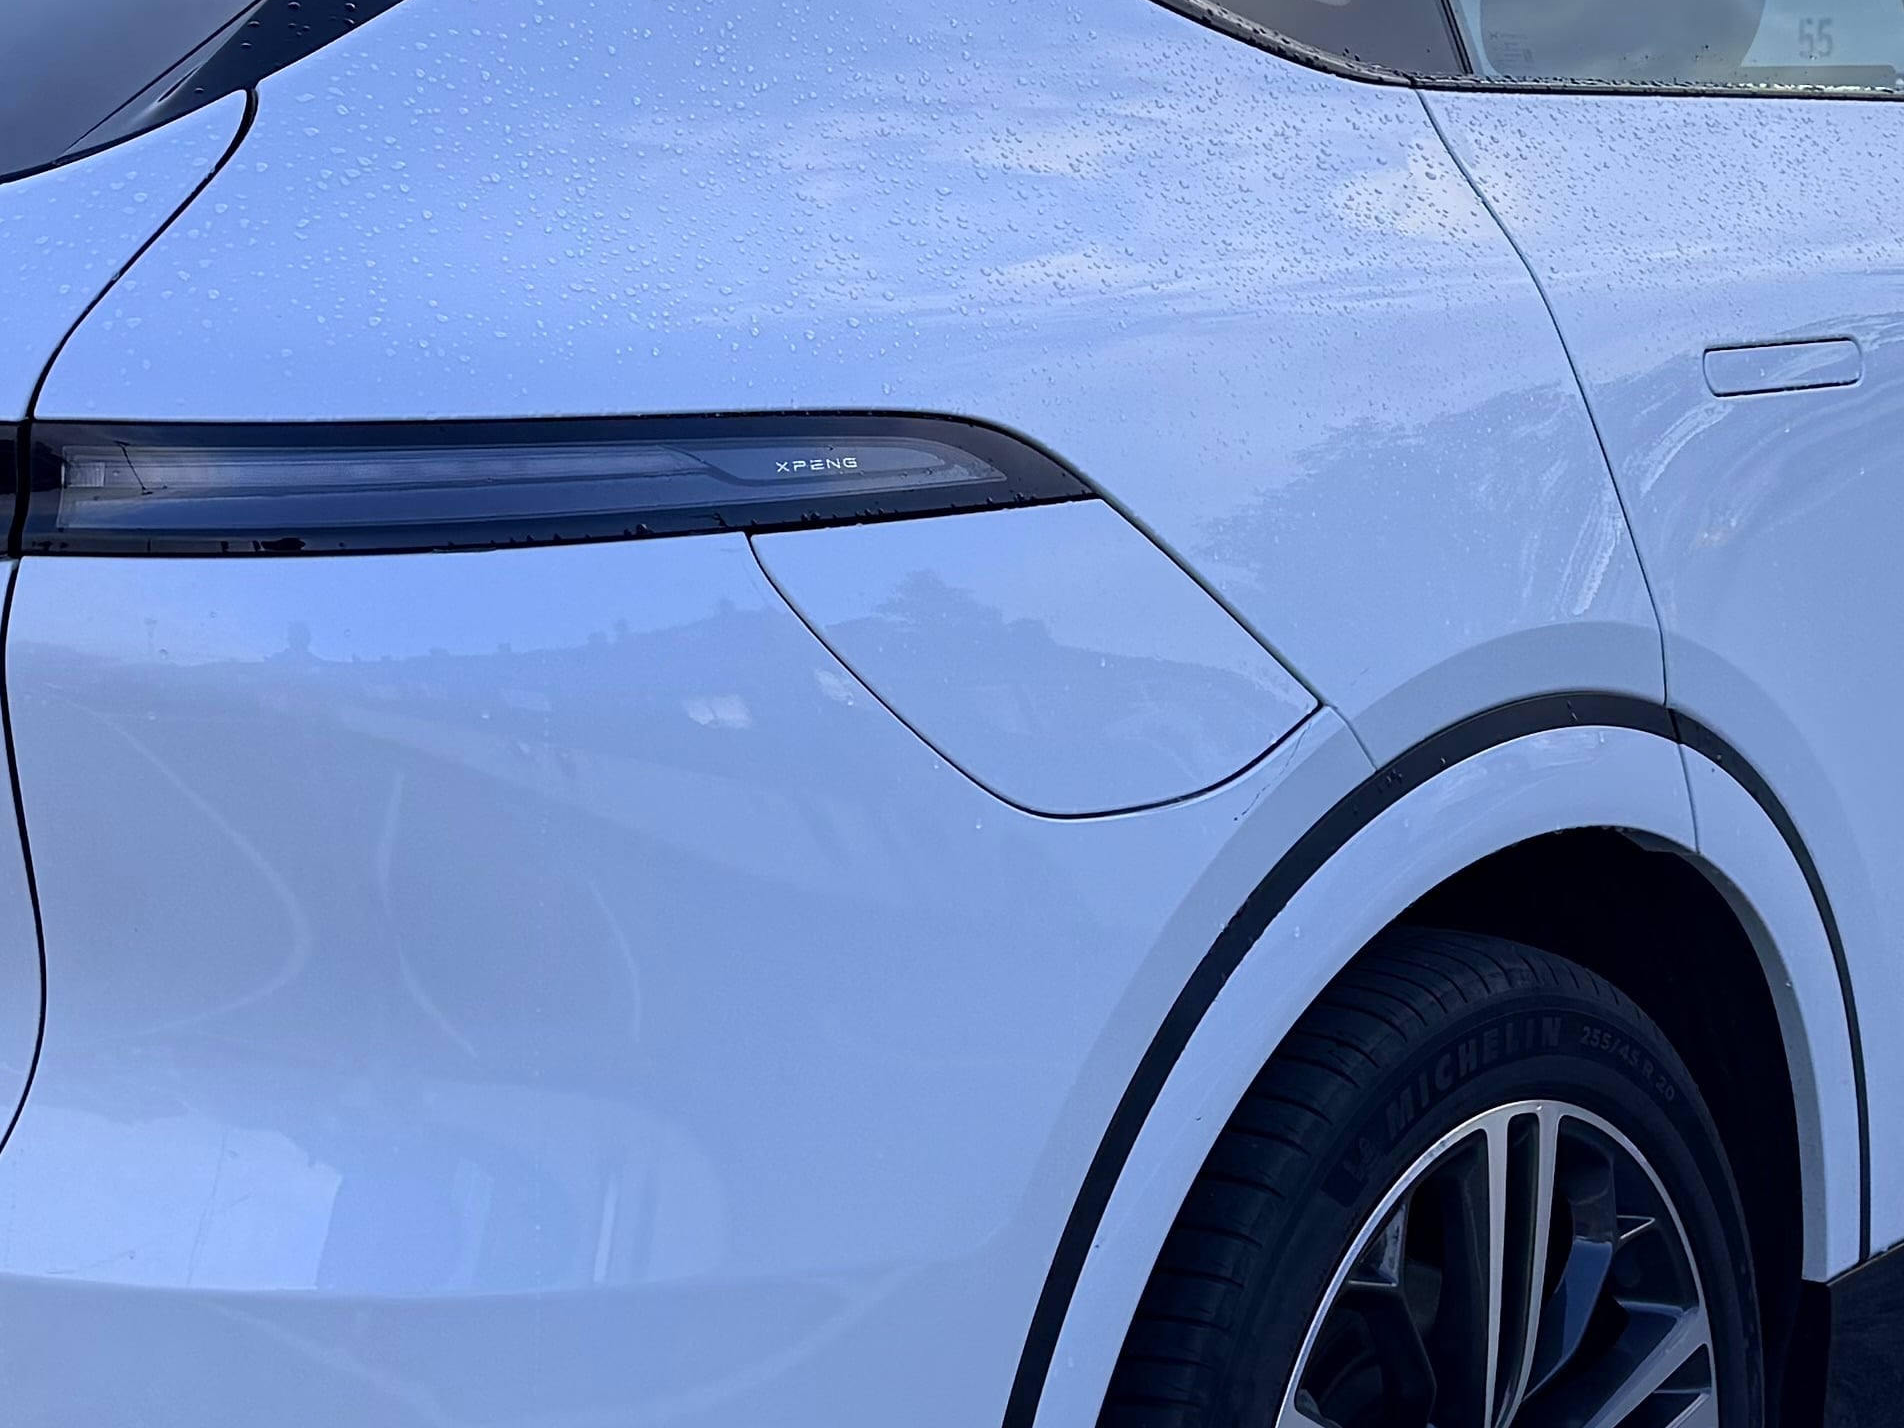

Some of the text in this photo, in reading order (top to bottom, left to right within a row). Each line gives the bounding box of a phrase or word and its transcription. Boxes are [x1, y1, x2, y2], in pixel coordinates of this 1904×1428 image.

[1798, 18, 1833, 59] 55
[776, 457, 858, 473] XPENG
[1385, 1016, 1561, 1136] MICHELIN
[1580, 1025, 1640, 1067] 255/45
[1655, 1078, 1675, 1101] 20
